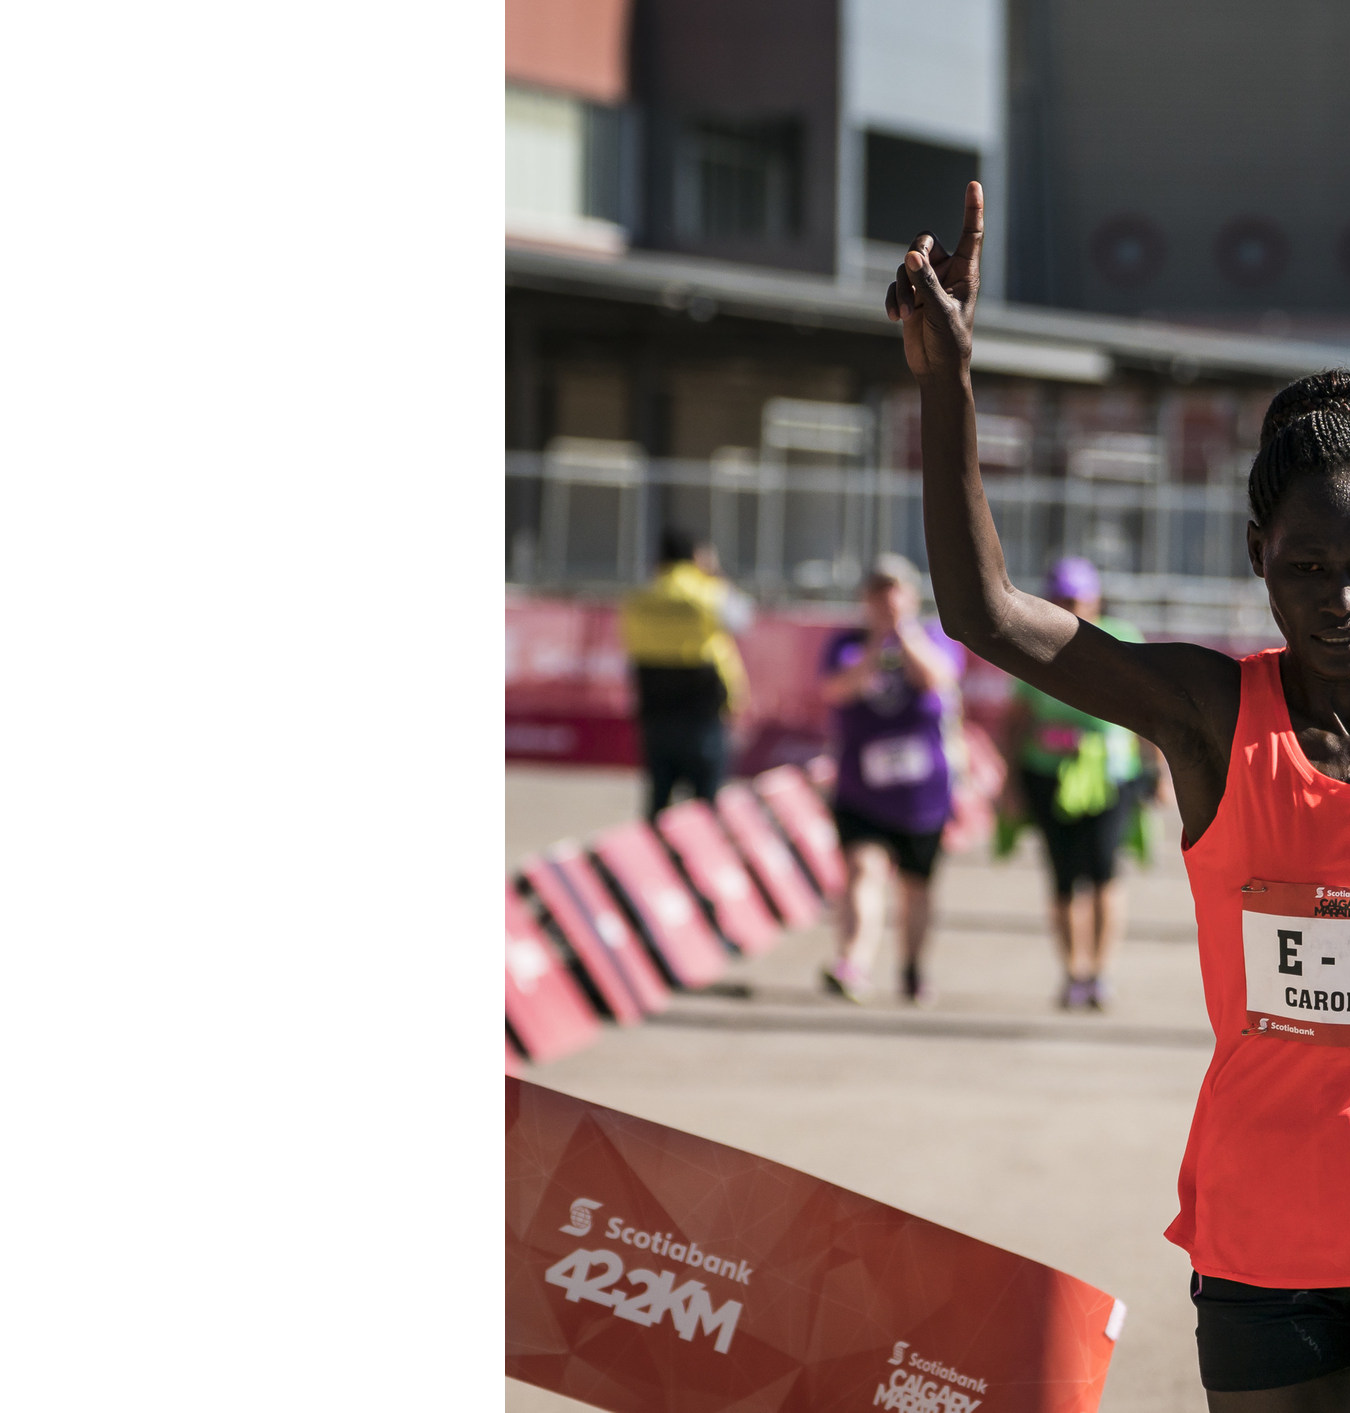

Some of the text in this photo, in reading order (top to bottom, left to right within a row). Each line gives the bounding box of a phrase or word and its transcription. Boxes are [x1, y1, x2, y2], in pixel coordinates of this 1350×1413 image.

[1277, 929, 1303, 977] E
[1321, 956, 1336, 966] -
[1271, 1021, 1315, 1037] Scotiabank
[605, 1216, 753, 1286] Scotiabank
[889, 1368, 984, 1413] CALGARY
[908, 1352, 988, 1394] Scotiabank
